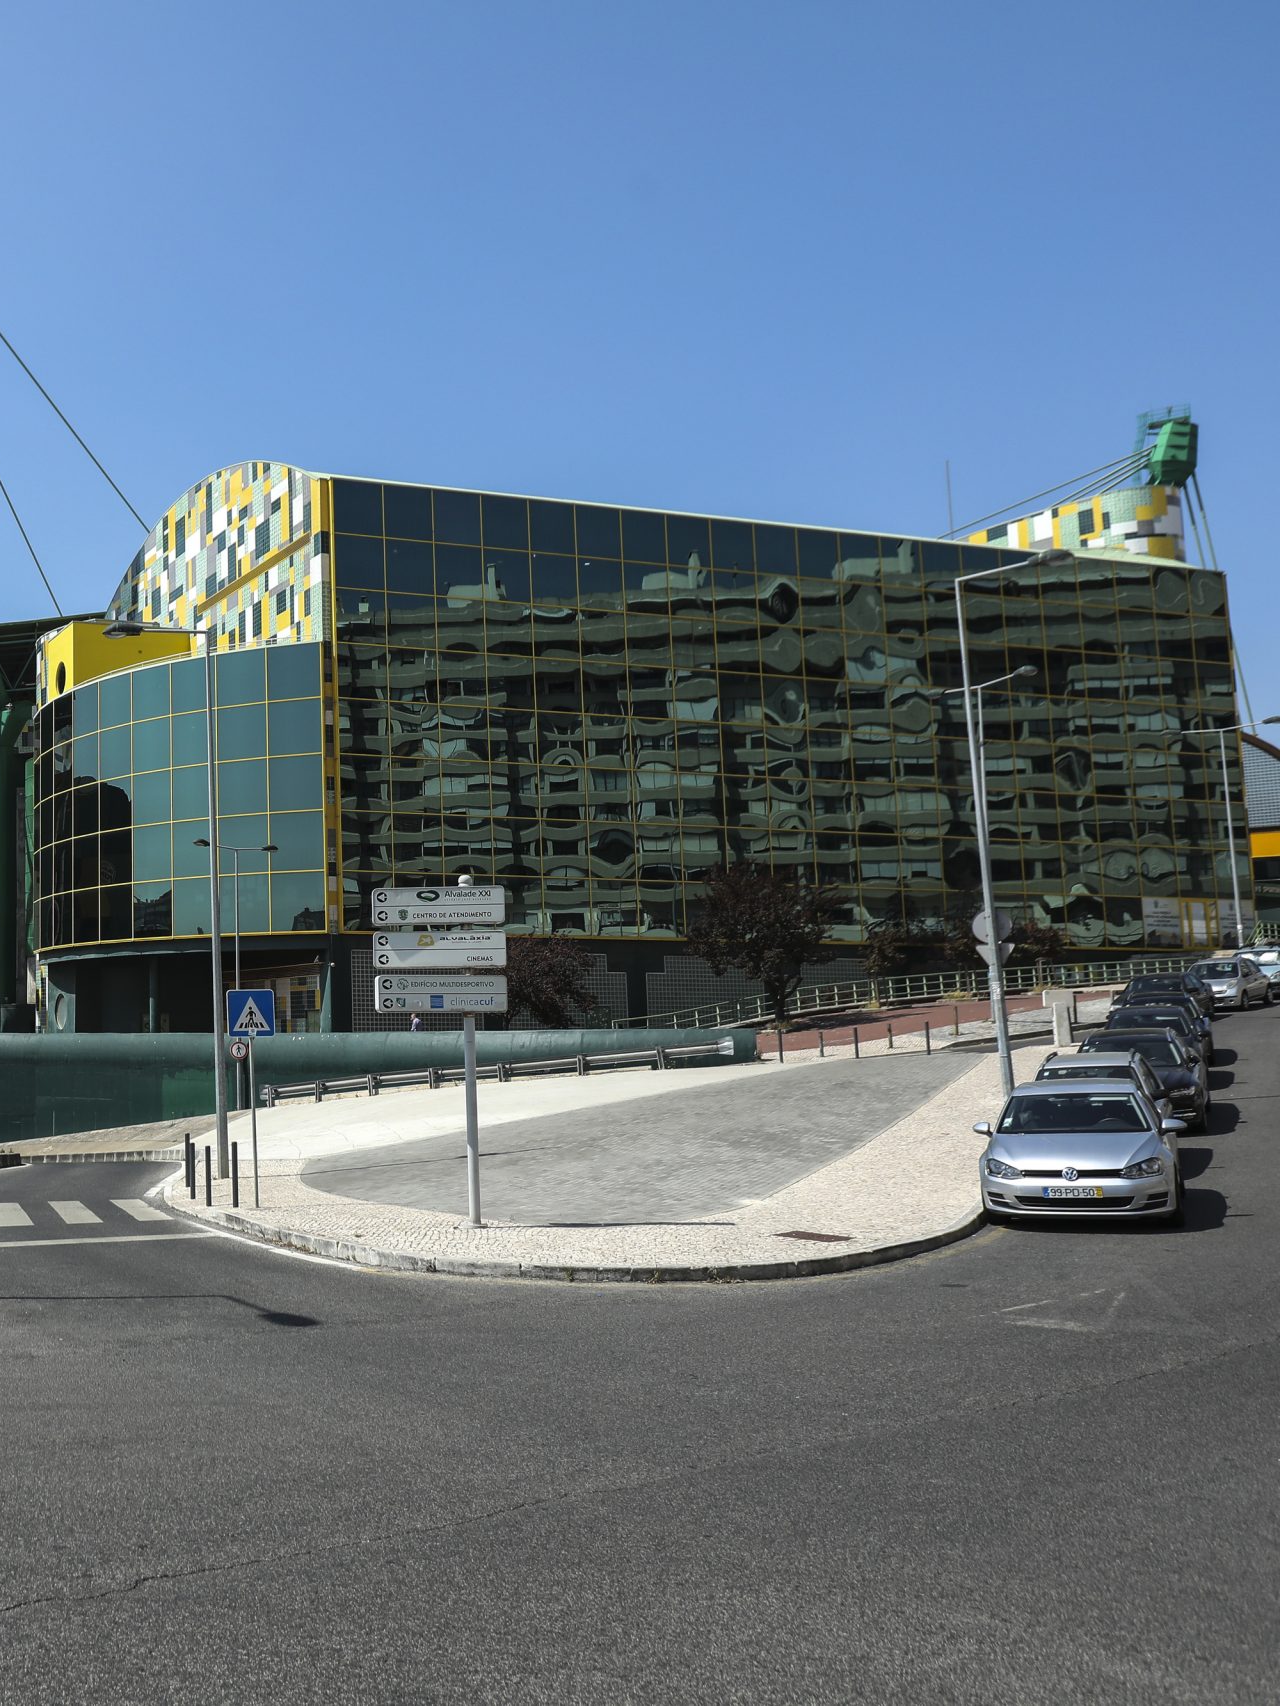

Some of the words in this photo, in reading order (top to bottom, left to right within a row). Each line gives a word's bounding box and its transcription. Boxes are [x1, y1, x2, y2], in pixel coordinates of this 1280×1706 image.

[444, 890, 477, 898] Alvalade
[478, 889, 491, 897] XXI
[448, 911, 492, 919] ATENDIMENTO
[410, 979, 438, 988] EDIFÍCIO
[439, 980, 495, 988] MULTIDESPORTIVO
